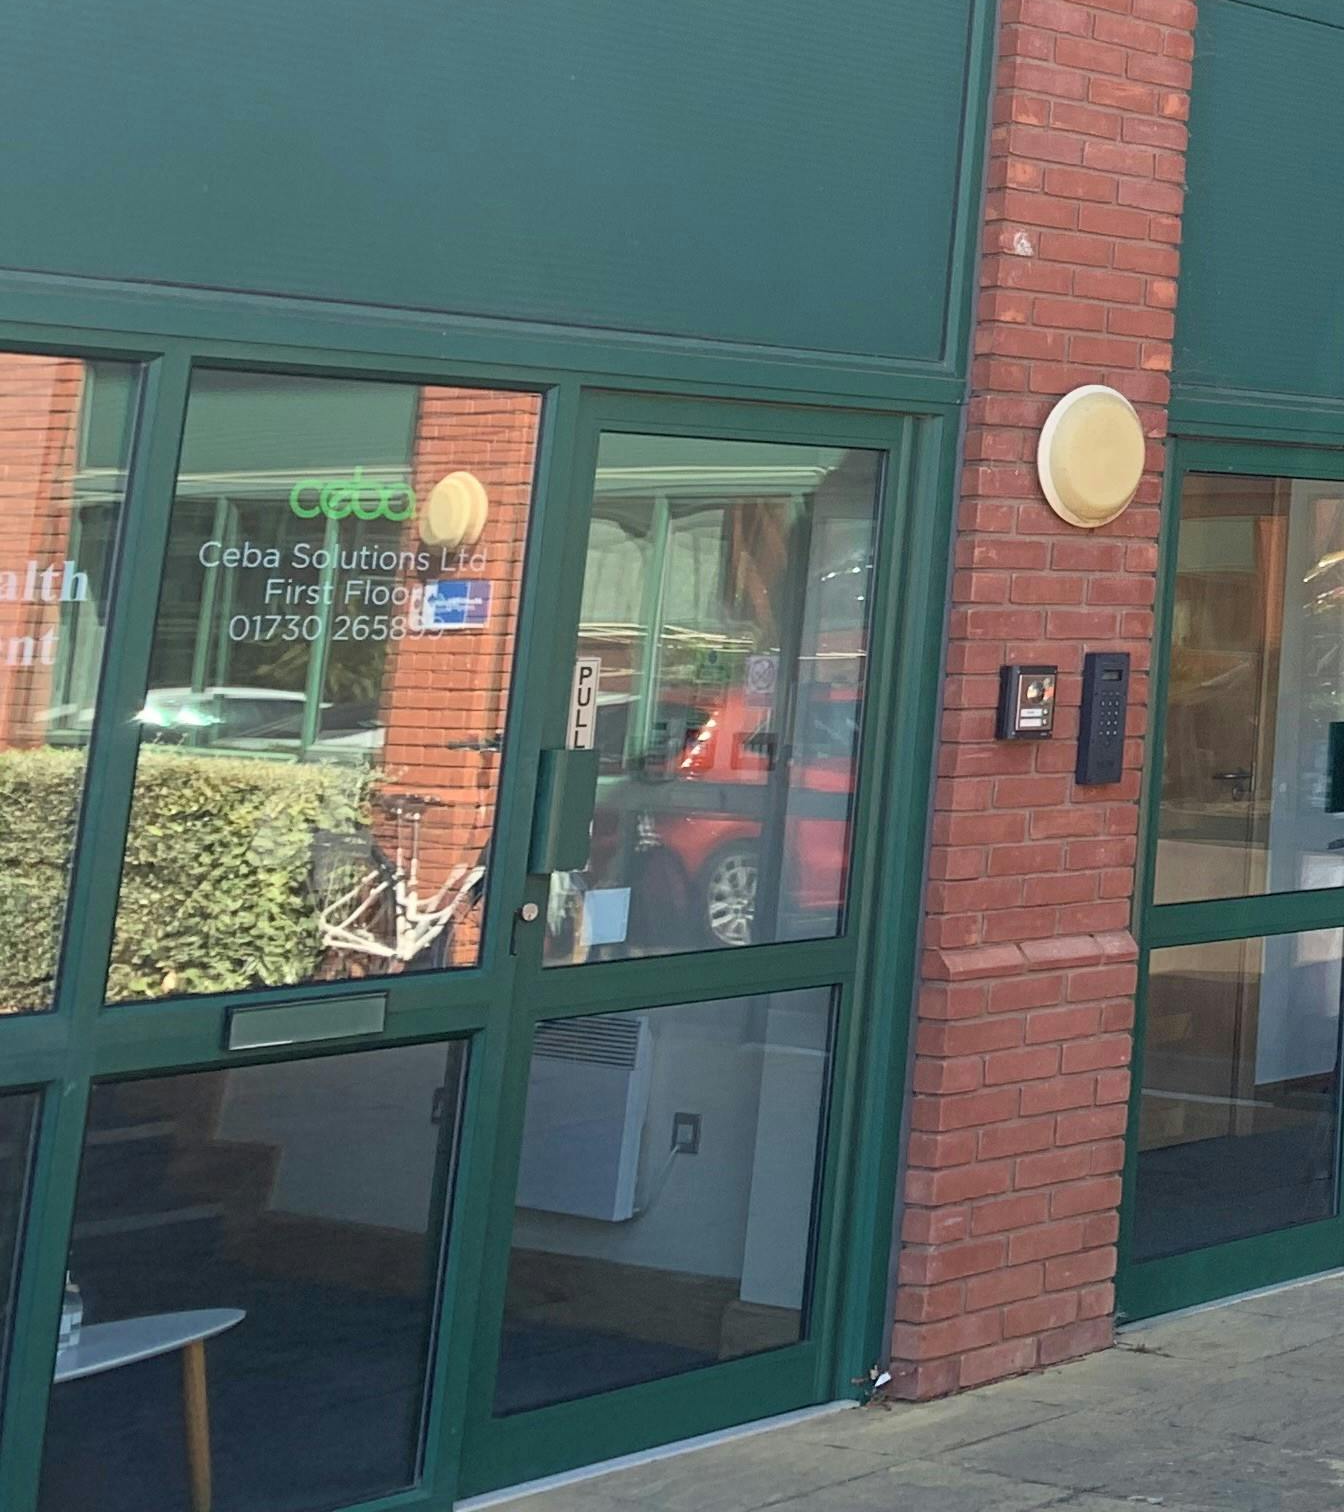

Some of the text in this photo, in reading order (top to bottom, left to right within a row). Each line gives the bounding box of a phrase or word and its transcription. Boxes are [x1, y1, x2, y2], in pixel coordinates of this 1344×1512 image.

[289, 465, 416, 522] ceba
[198, 541, 488, 572] Ceba Solutions Ltd
[264, 579, 334, 606] First
[344, 579, 422, 606] Floor
[0, 626, 59, 667] nt
[228, 615, 446, 642] 01730 265899
[574, 666, 593, 749] PULL
